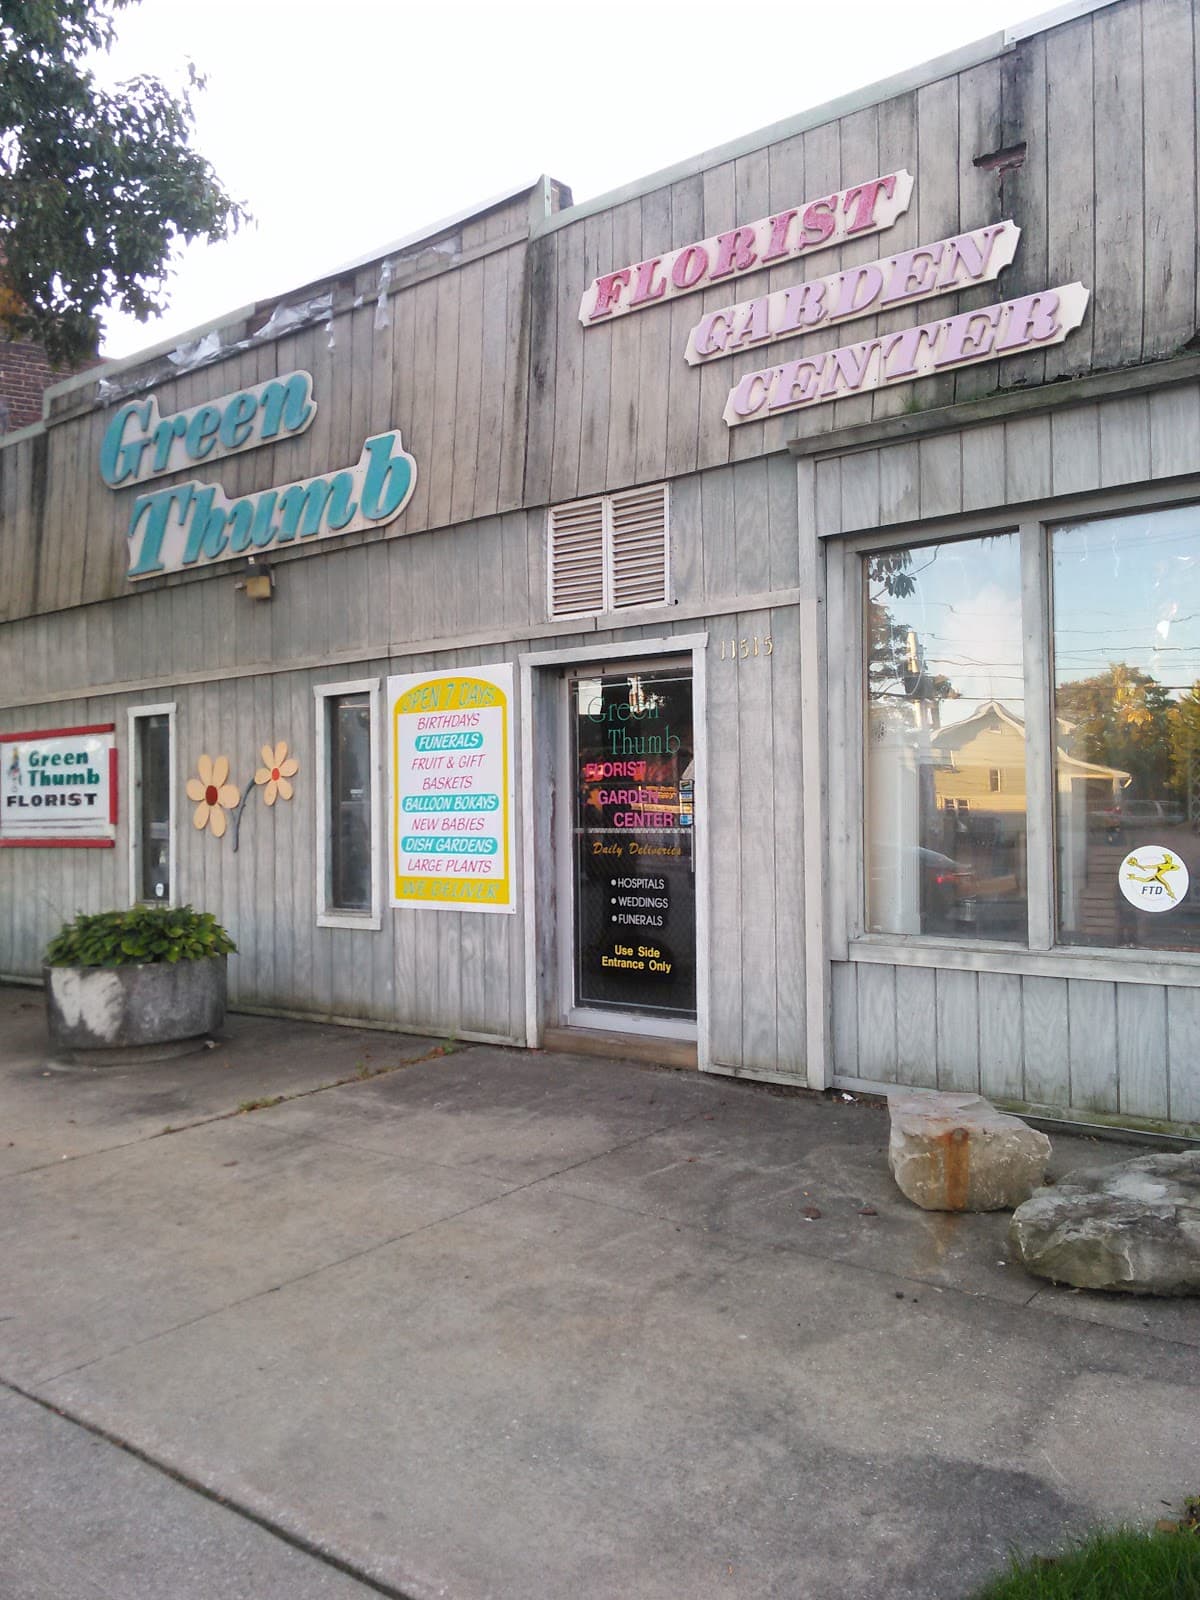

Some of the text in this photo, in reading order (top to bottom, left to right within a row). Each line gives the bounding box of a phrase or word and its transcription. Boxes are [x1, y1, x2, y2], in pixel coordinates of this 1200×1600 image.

[589, 175, 898, 319] FLORIST
[694, 225, 1005, 356] GARDEN
[732, 290, 1063, 416] CENTER
[101, 373, 314, 485] Green
[128, 433, 412, 577] Thumb
[720, 636, 774, 660] 11515
[402, 682, 497, 711] OPEN 7 DAYS
[588, 696, 660, 723] Green
[417, 712, 480, 731] BIRTHDAYS
[418, 732, 480, 750] FUNERALS
[608, 724, 681, 755] Thumb
[29, 750, 89, 767] Green
[411, 753, 486, 771] FRUIT & GIFT
[28, 768, 100, 787] Thumb
[586, 761, 647, 778] FLORIST
[422, 776, 473, 791] BASKETS
[7, 793, 97, 807] FLORIST
[405, 795, 497, 811] BALLOON BOKAYS
[598, 789, 660, 805] GARDEN
[411, 817, 485, 831] NEW BABIES
[613, 812, 674, 827] CENTER
[405, 838, 493, 853] DISH GARDENS
[592, 841, 682, 857] Daily Deliveries
[407, 858, 492, 873] LARGE PLANTS
[402, 880, 500, 899] WE DELIVER
[618, 878, 665, 890] HOSPITALS
[1142, 886, 1163, 895] FTD
[618, 896, 669, 909] WEDDINGS
[618, 914, 663, 927] FUNERALS
[615, 945, 661, 958] Use Side
[601, 957, 672, 974] Entrance Only
